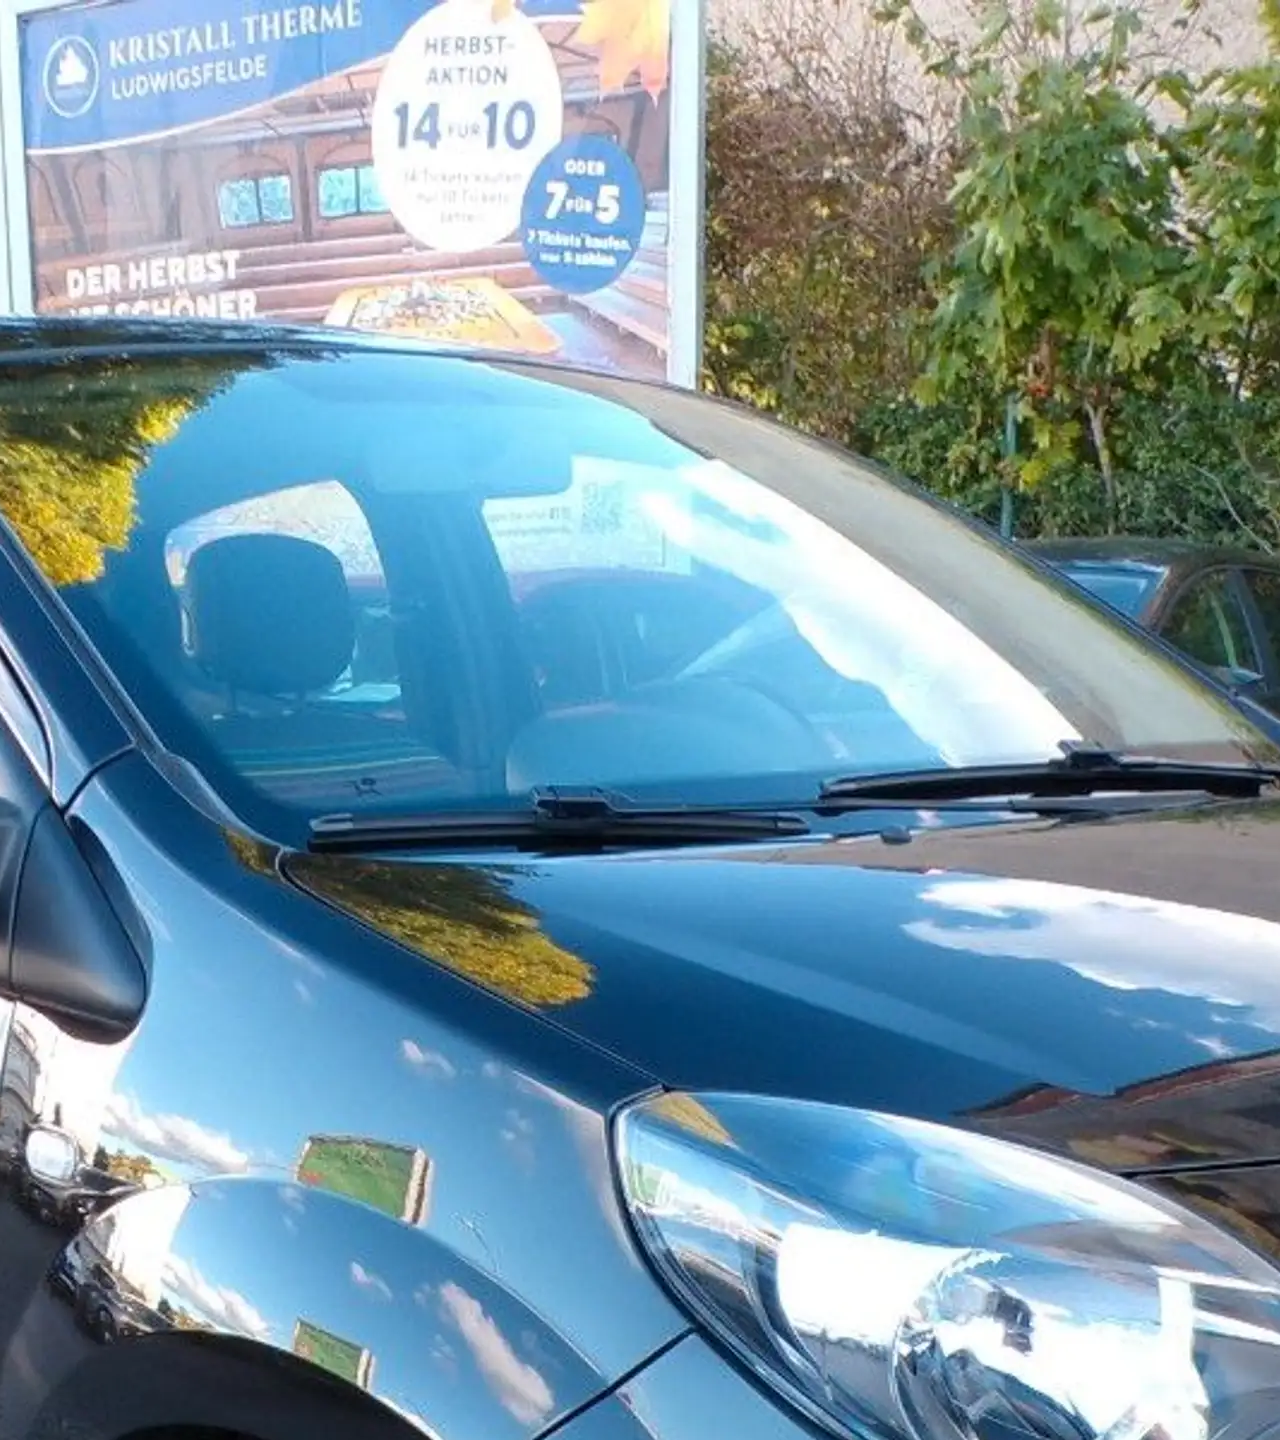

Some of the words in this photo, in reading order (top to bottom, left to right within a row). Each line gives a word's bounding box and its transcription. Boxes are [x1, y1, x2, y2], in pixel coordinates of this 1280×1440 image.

[108, 21, 236, 68] KRISTALL
[242, 0, 363, 45] THERME
[111, 54, 269, 100] LUDWIGSFELDE
[426, 66, 508, 85] AKTION
[393, 101, 442, 150] 14
[483, 99, 536, 150] 10
[563, 158, 606, 177] ODER
[545, 180, 568, 220] 7
[595, 184, 621, 225] 5
[66, 263, 122, 299] DER
[128, 250, 240, 291] HERBST
